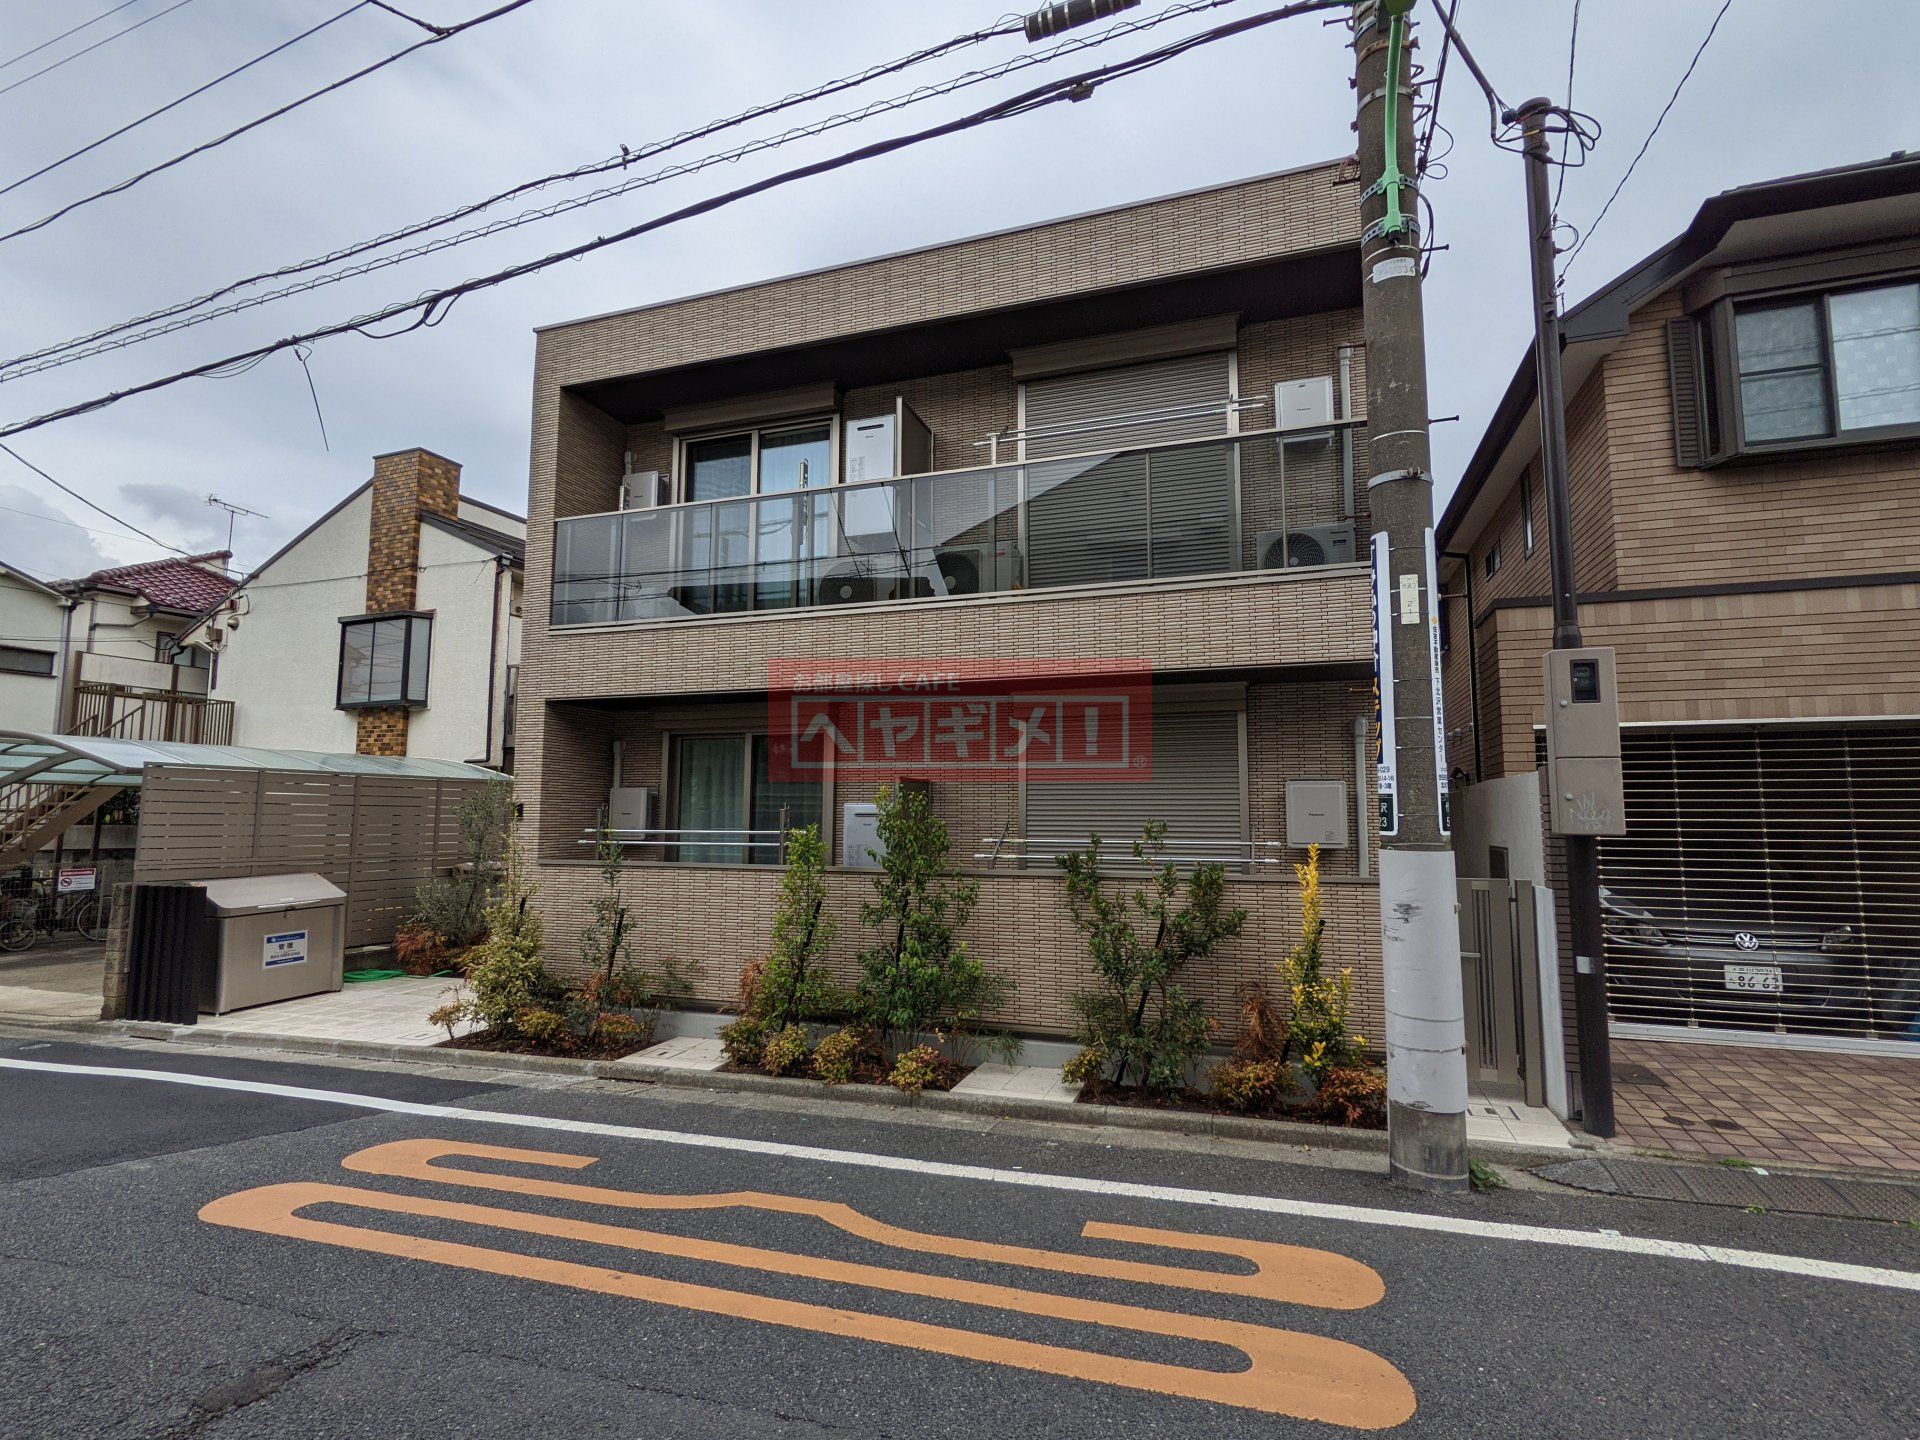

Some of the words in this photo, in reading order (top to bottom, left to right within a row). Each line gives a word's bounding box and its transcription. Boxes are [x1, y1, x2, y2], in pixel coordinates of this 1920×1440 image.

[1434, 677, 1444, 763] 下北沢営業センター
